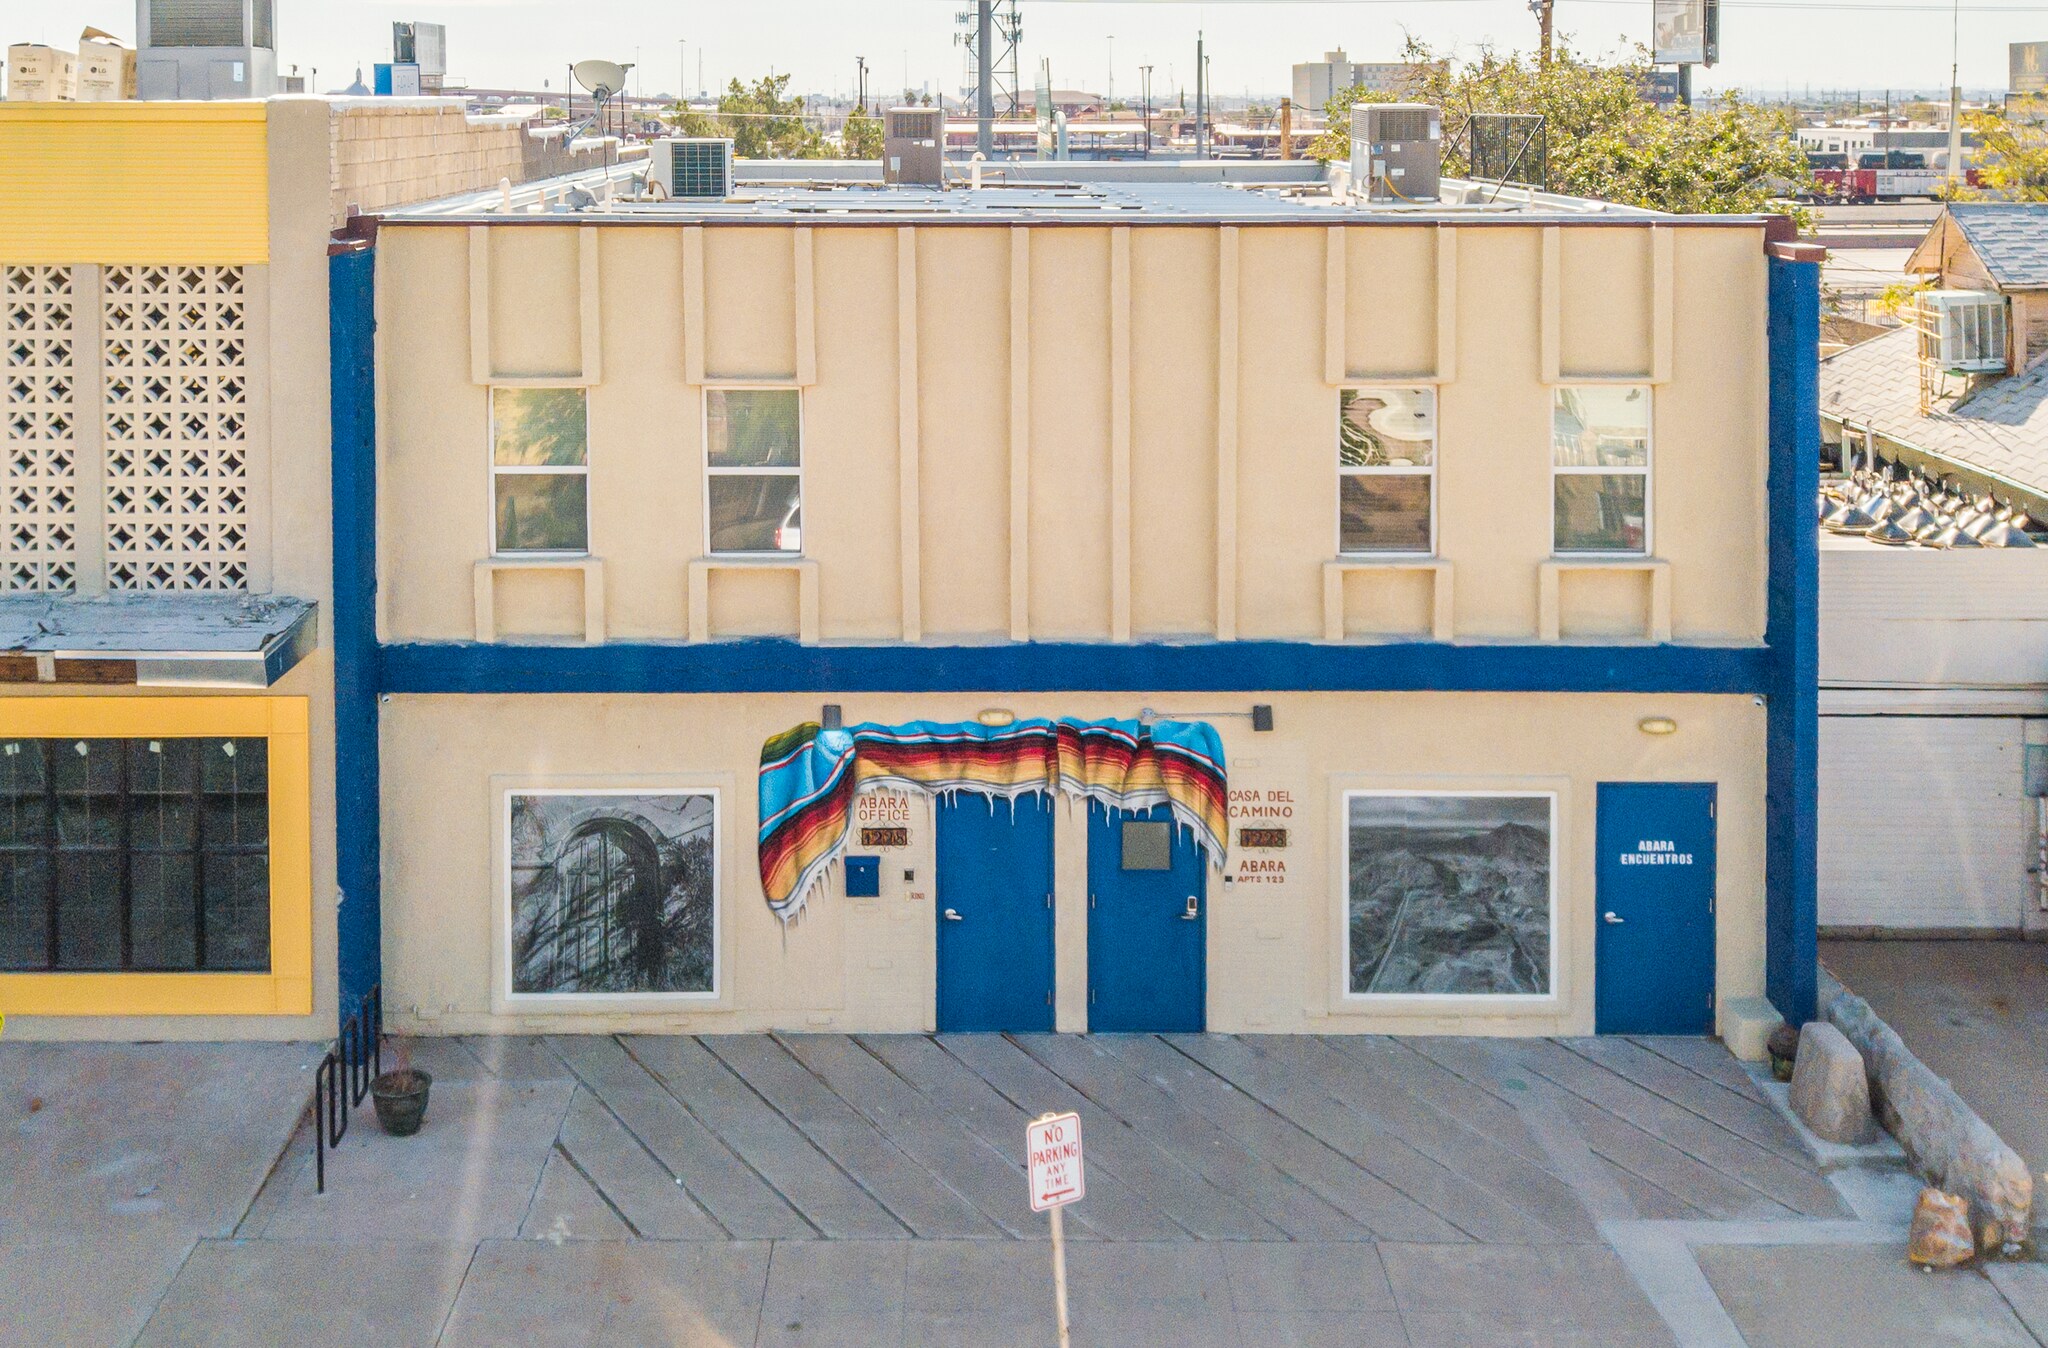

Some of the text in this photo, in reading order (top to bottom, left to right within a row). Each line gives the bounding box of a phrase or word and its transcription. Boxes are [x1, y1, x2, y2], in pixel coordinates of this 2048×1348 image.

[1229, 790, 1294, 802] CASA DEL
[859, 797, 908, 809] ABARA
[859, 809, 910, 820] OFFICE
[1229, 806, 1292, 818] CAMINO
[1638, 840, 1675, 851] ABARA
[1621, 853, 1693, 865] ENCUENTROS
[1240, 860, 1286, 872] ABARA
[1237, 875, 1284, 883] APTS 123
[1044, 1127, 1063, 1145] NO
[1033, 1142, 1077, 1167] PARKING
[1047, 1163, 1066, 1176] ANY
[1045, 1175, 1068, 1190] TIME
